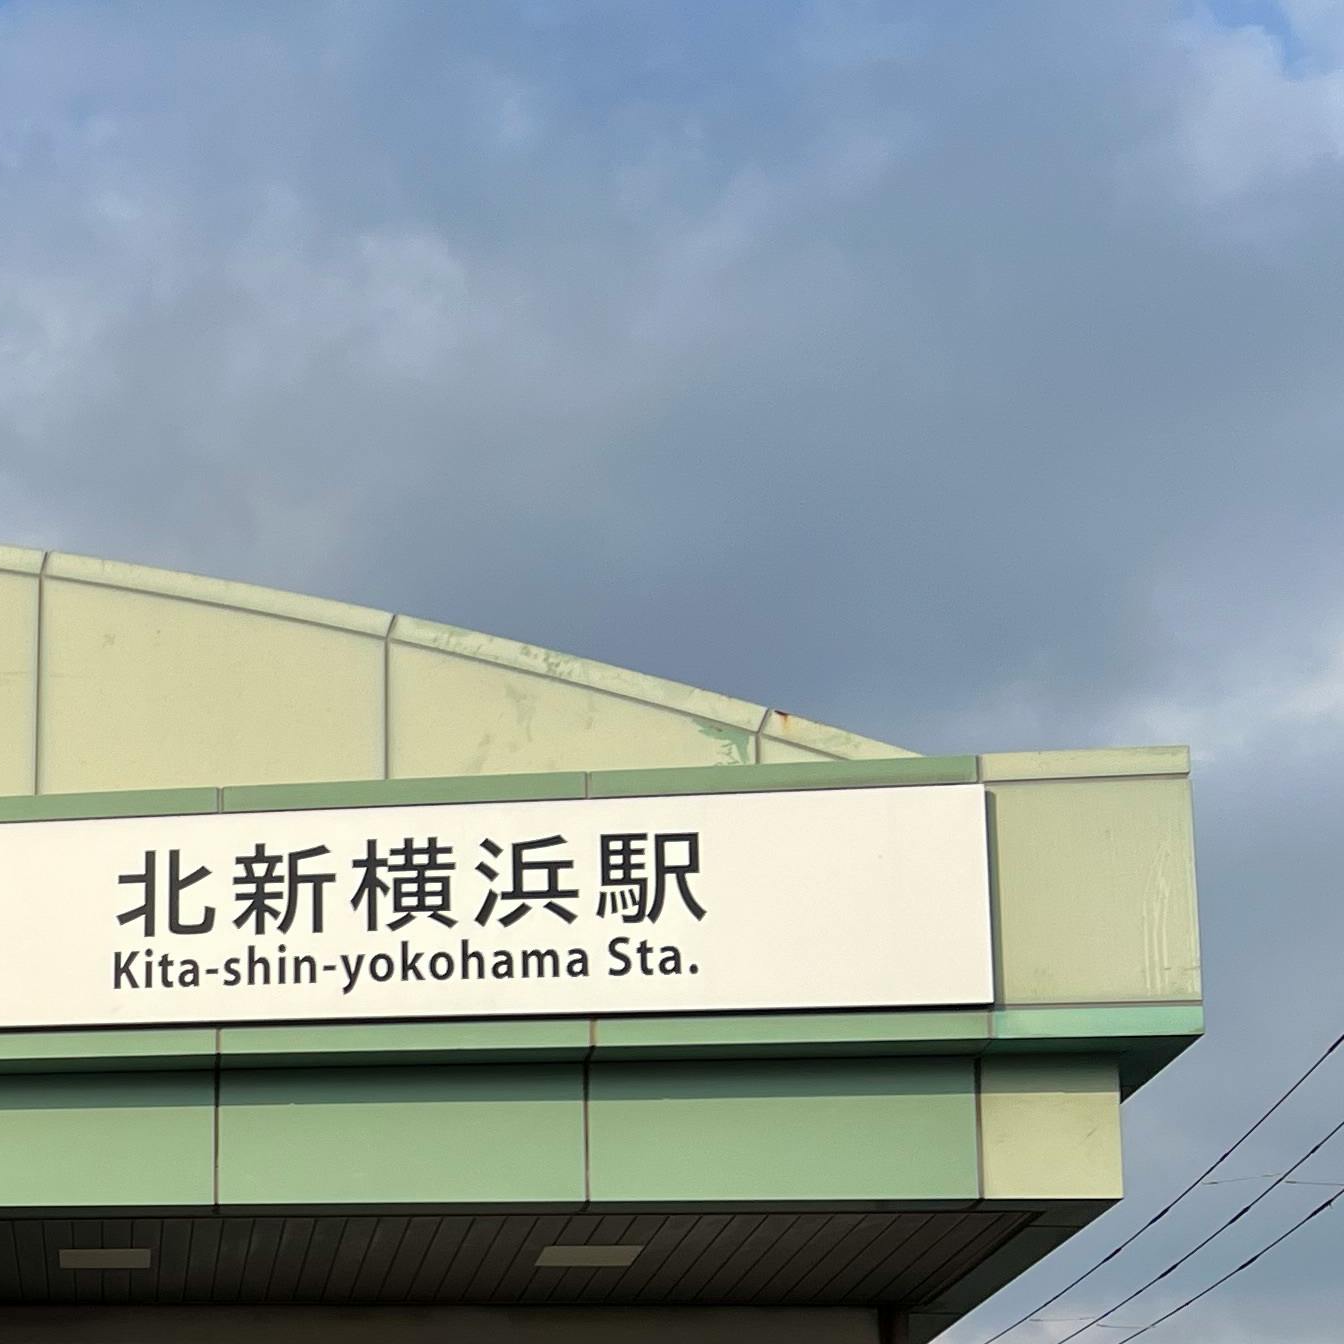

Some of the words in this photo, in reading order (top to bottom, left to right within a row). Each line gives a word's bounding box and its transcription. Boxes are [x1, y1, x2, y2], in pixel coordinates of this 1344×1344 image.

[116, 832, 707, 938] 北新横浜駅
[114, 938, 590, 996] Kita-shin-yokohama
[607, 935, 700, 978] Sta.
